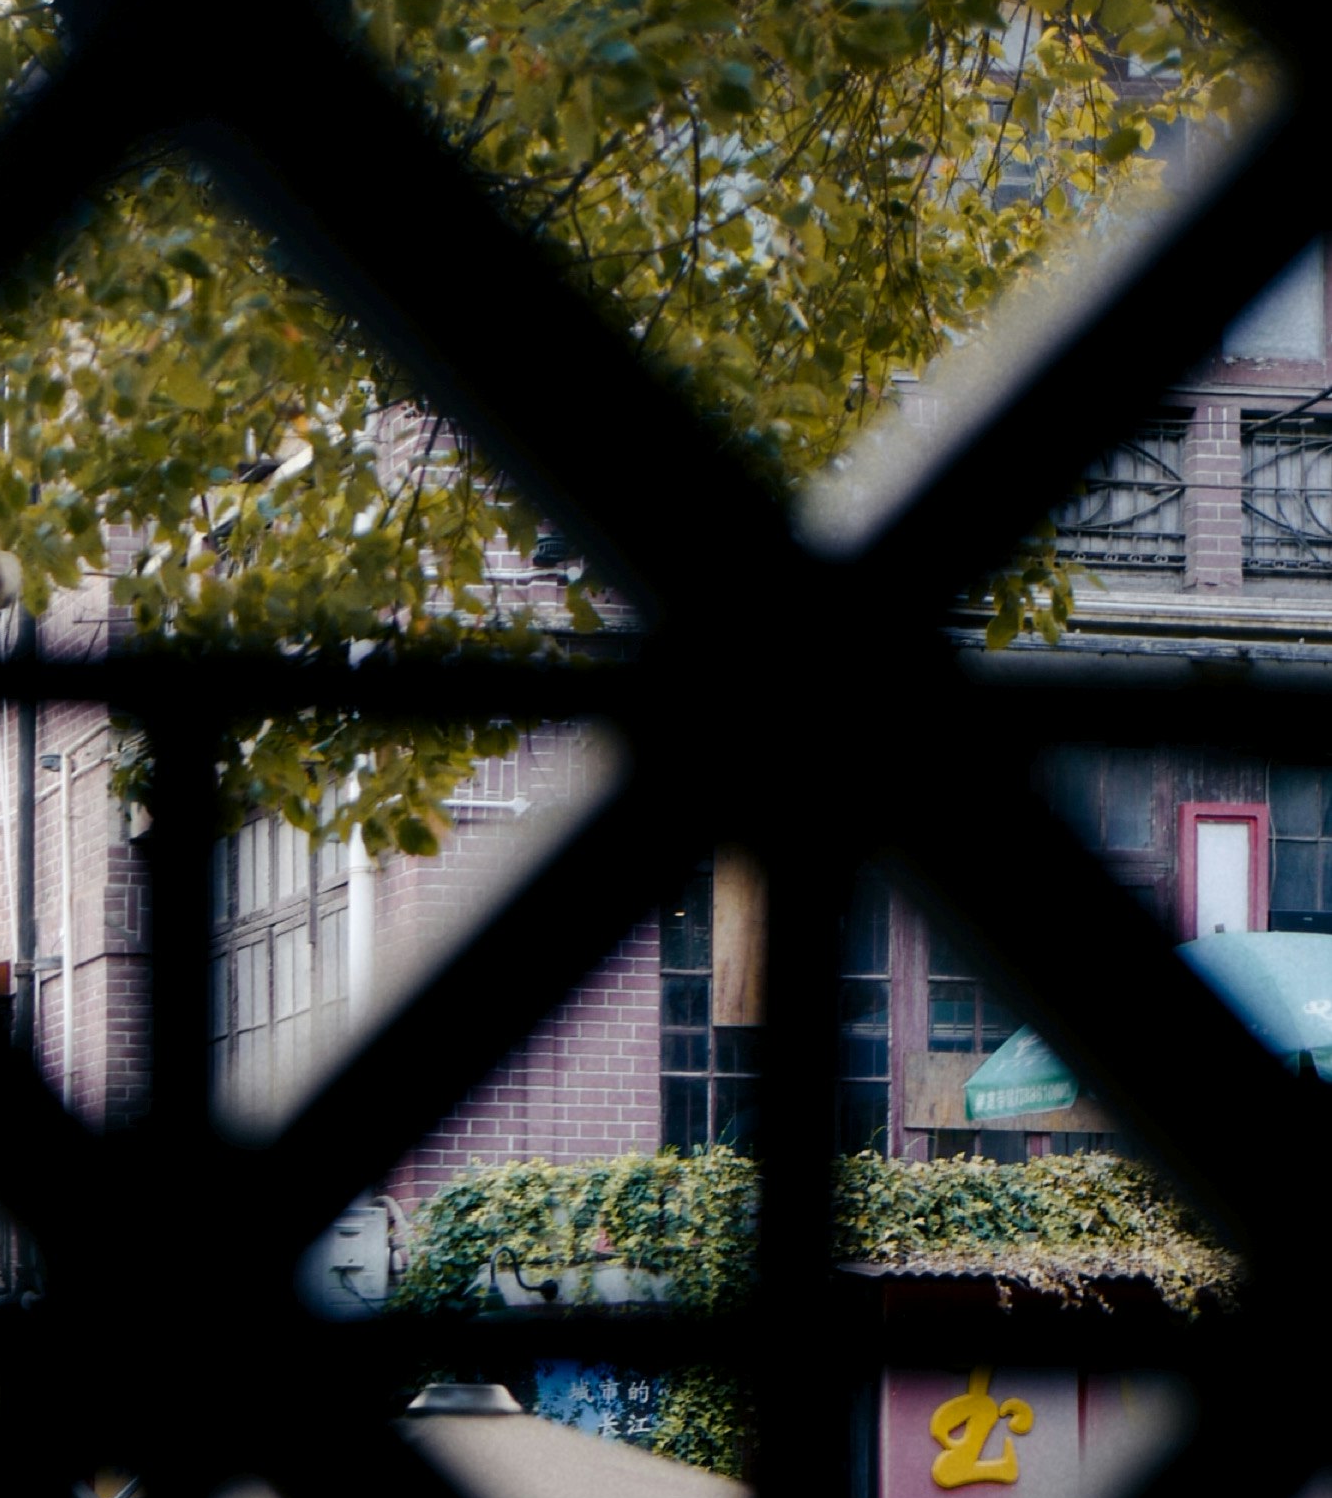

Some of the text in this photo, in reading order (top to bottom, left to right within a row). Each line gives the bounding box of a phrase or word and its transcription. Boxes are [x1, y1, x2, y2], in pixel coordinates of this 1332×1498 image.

[568, 1378, 650, 1403] 城市的
[597, 1411, 652, 1436] 长江
